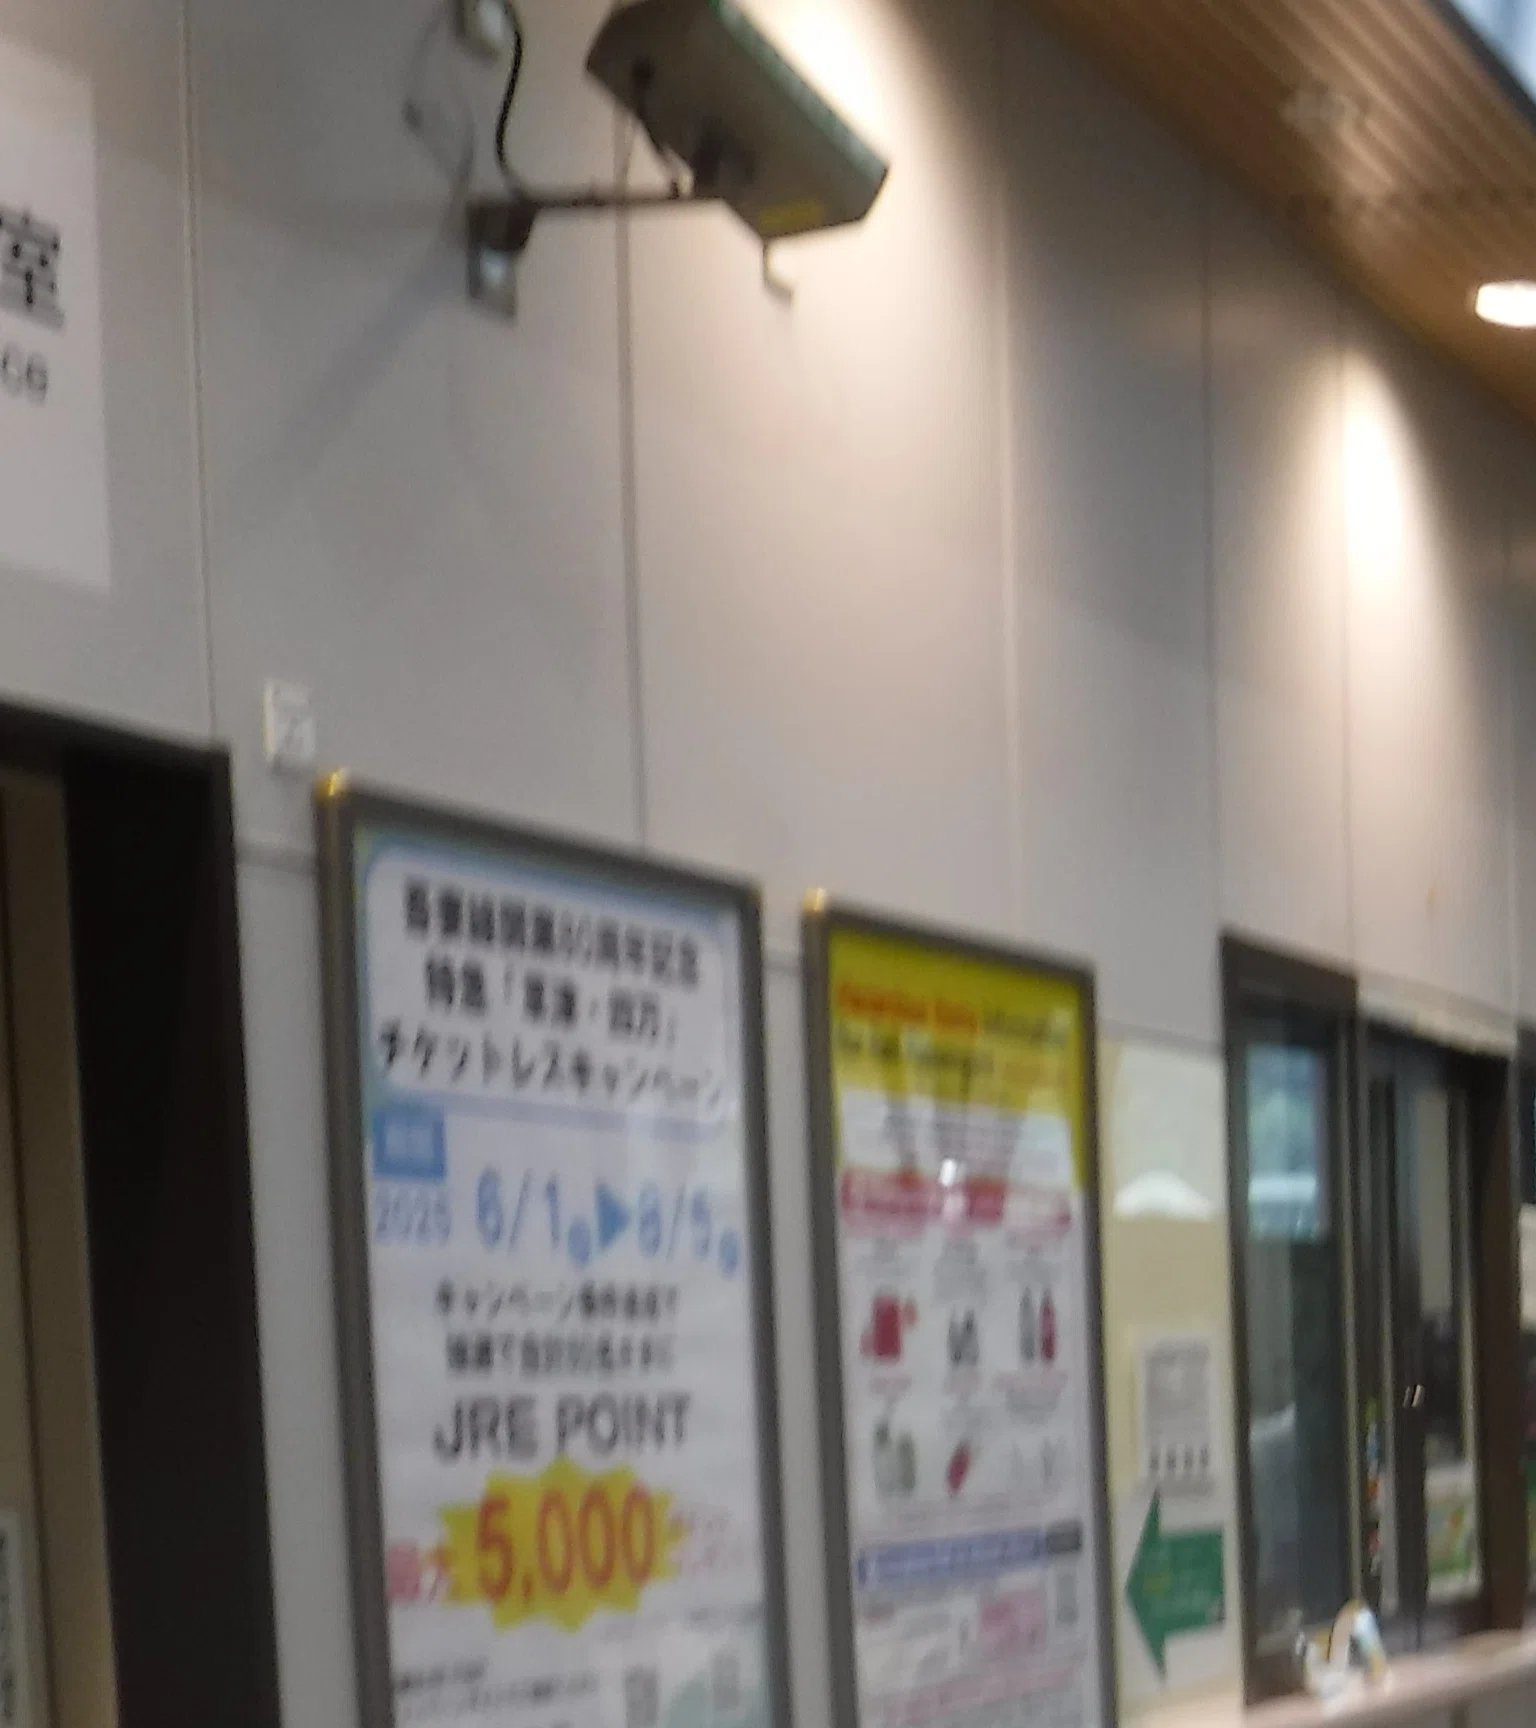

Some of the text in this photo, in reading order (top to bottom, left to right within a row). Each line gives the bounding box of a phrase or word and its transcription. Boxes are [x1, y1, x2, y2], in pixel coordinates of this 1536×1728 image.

[432, 1390, 691, 1461] JRE POINT
[478, 1487, 655, 1602] 5,000
